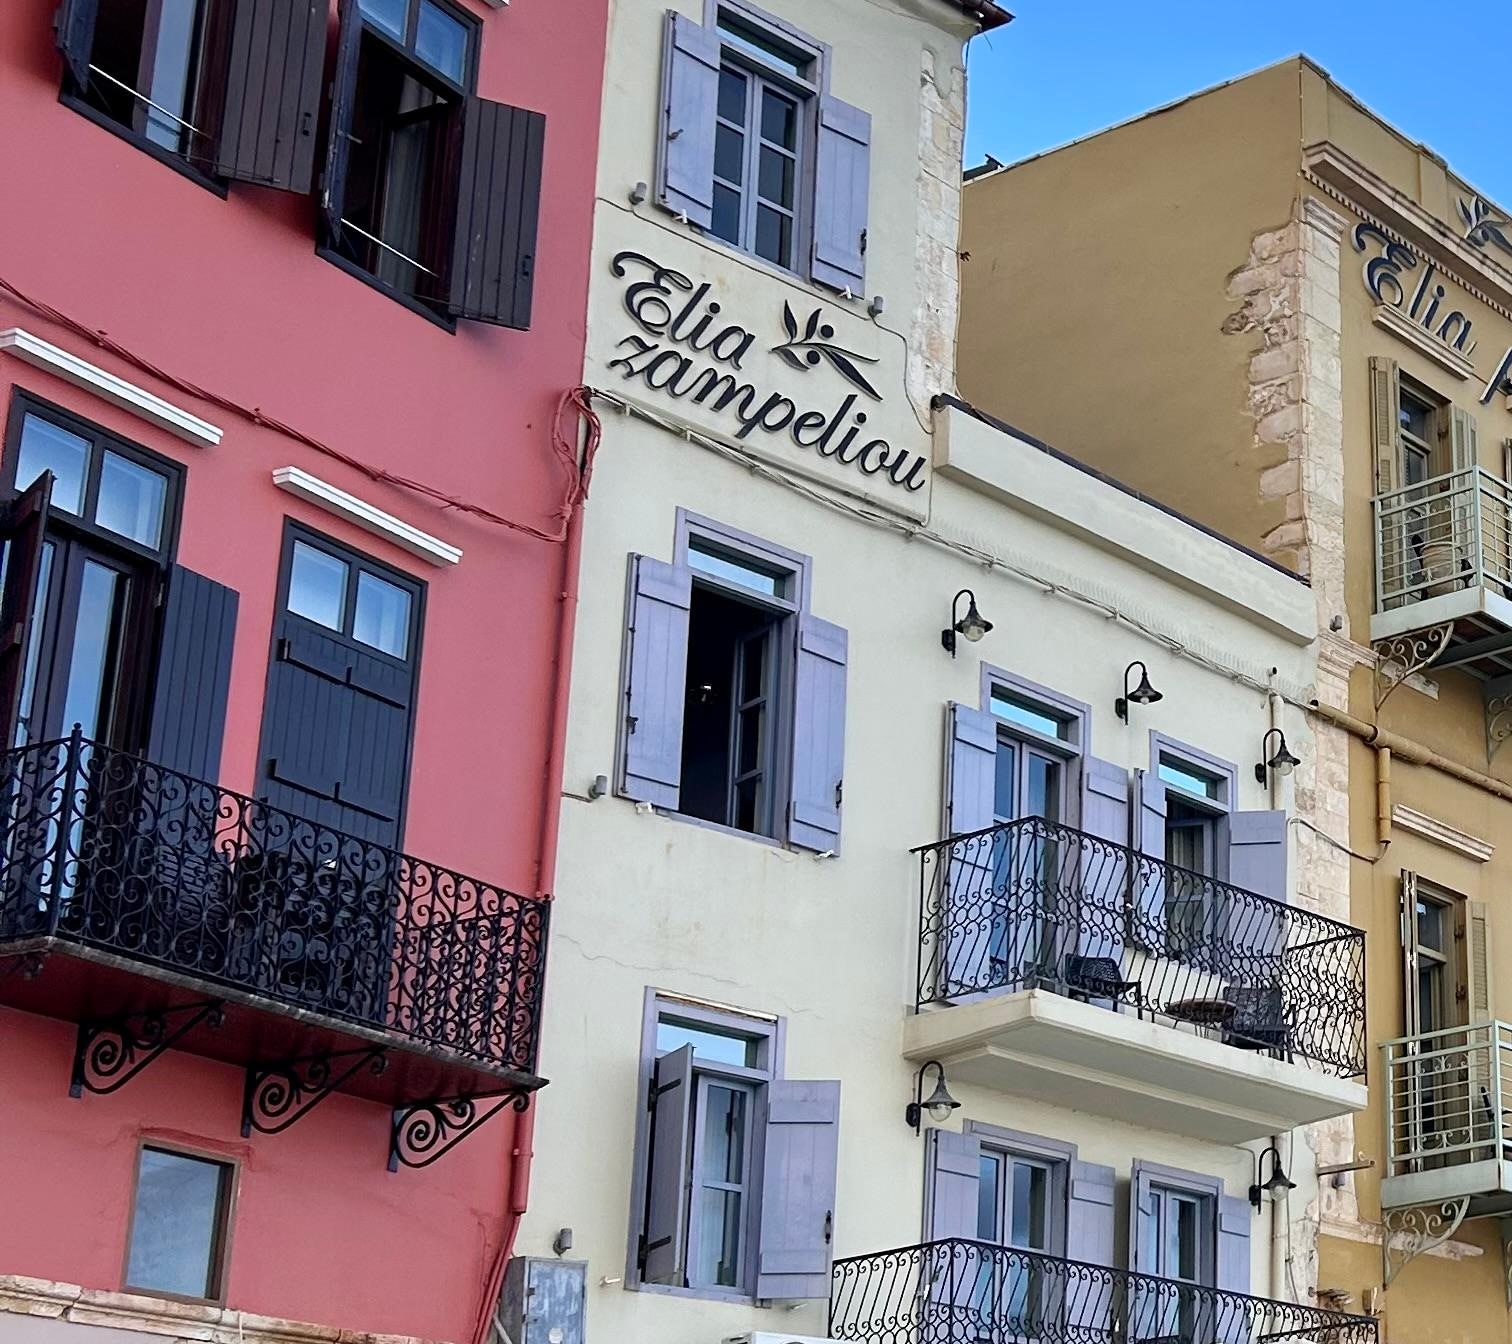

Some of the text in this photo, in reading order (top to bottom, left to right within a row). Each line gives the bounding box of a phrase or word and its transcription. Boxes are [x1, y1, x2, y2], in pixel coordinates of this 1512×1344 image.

[611, 250, 756, 371] Elia
[1350, 222, 1477, 356] Elia
[607, 335, 927, 493] zampeliou
